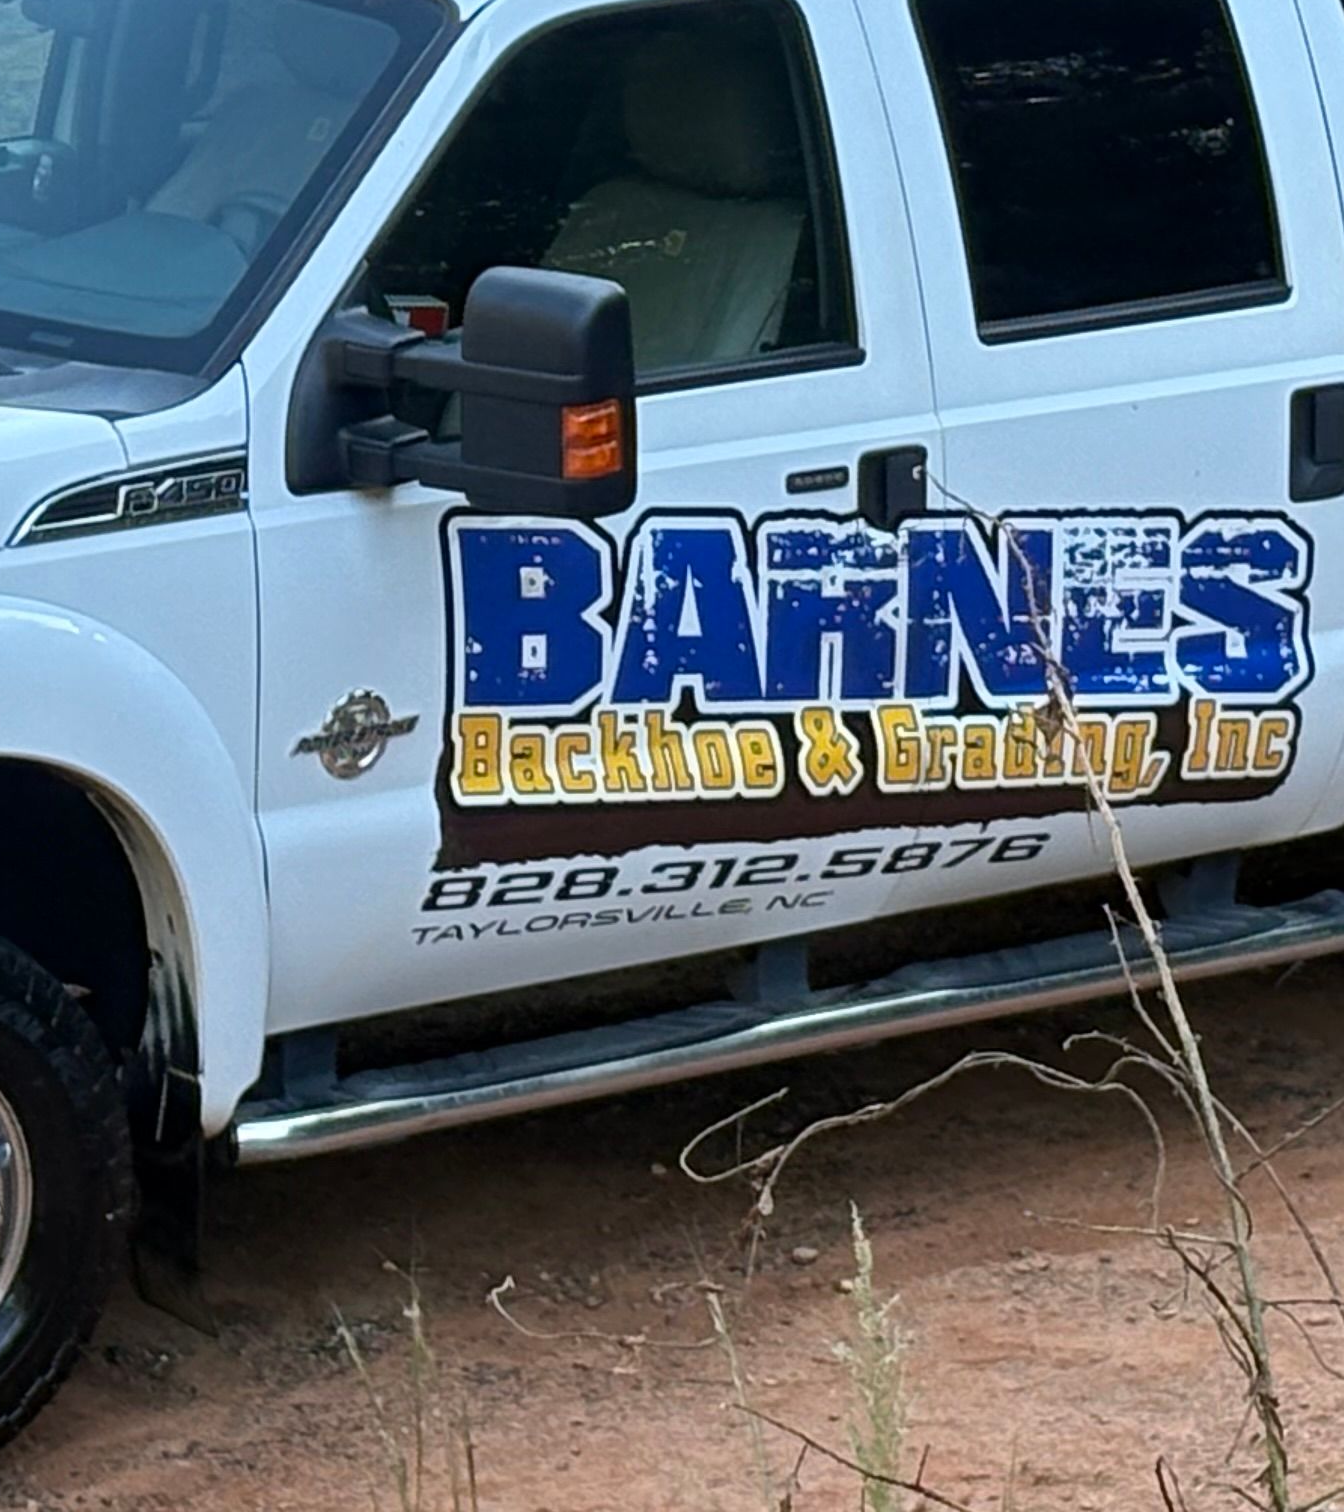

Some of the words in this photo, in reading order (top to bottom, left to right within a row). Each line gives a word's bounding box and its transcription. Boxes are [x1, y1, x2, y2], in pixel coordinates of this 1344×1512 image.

[451, 518, 1309, 712] BARNES
[456, 706, 778, 798] Backhoe
[798, 704, 862, 791] &
[1186, 697, 1292, 776] Inc
[421, 833, 1050, 912] 828.312.5876
[766, 890, 834, 911] NC
